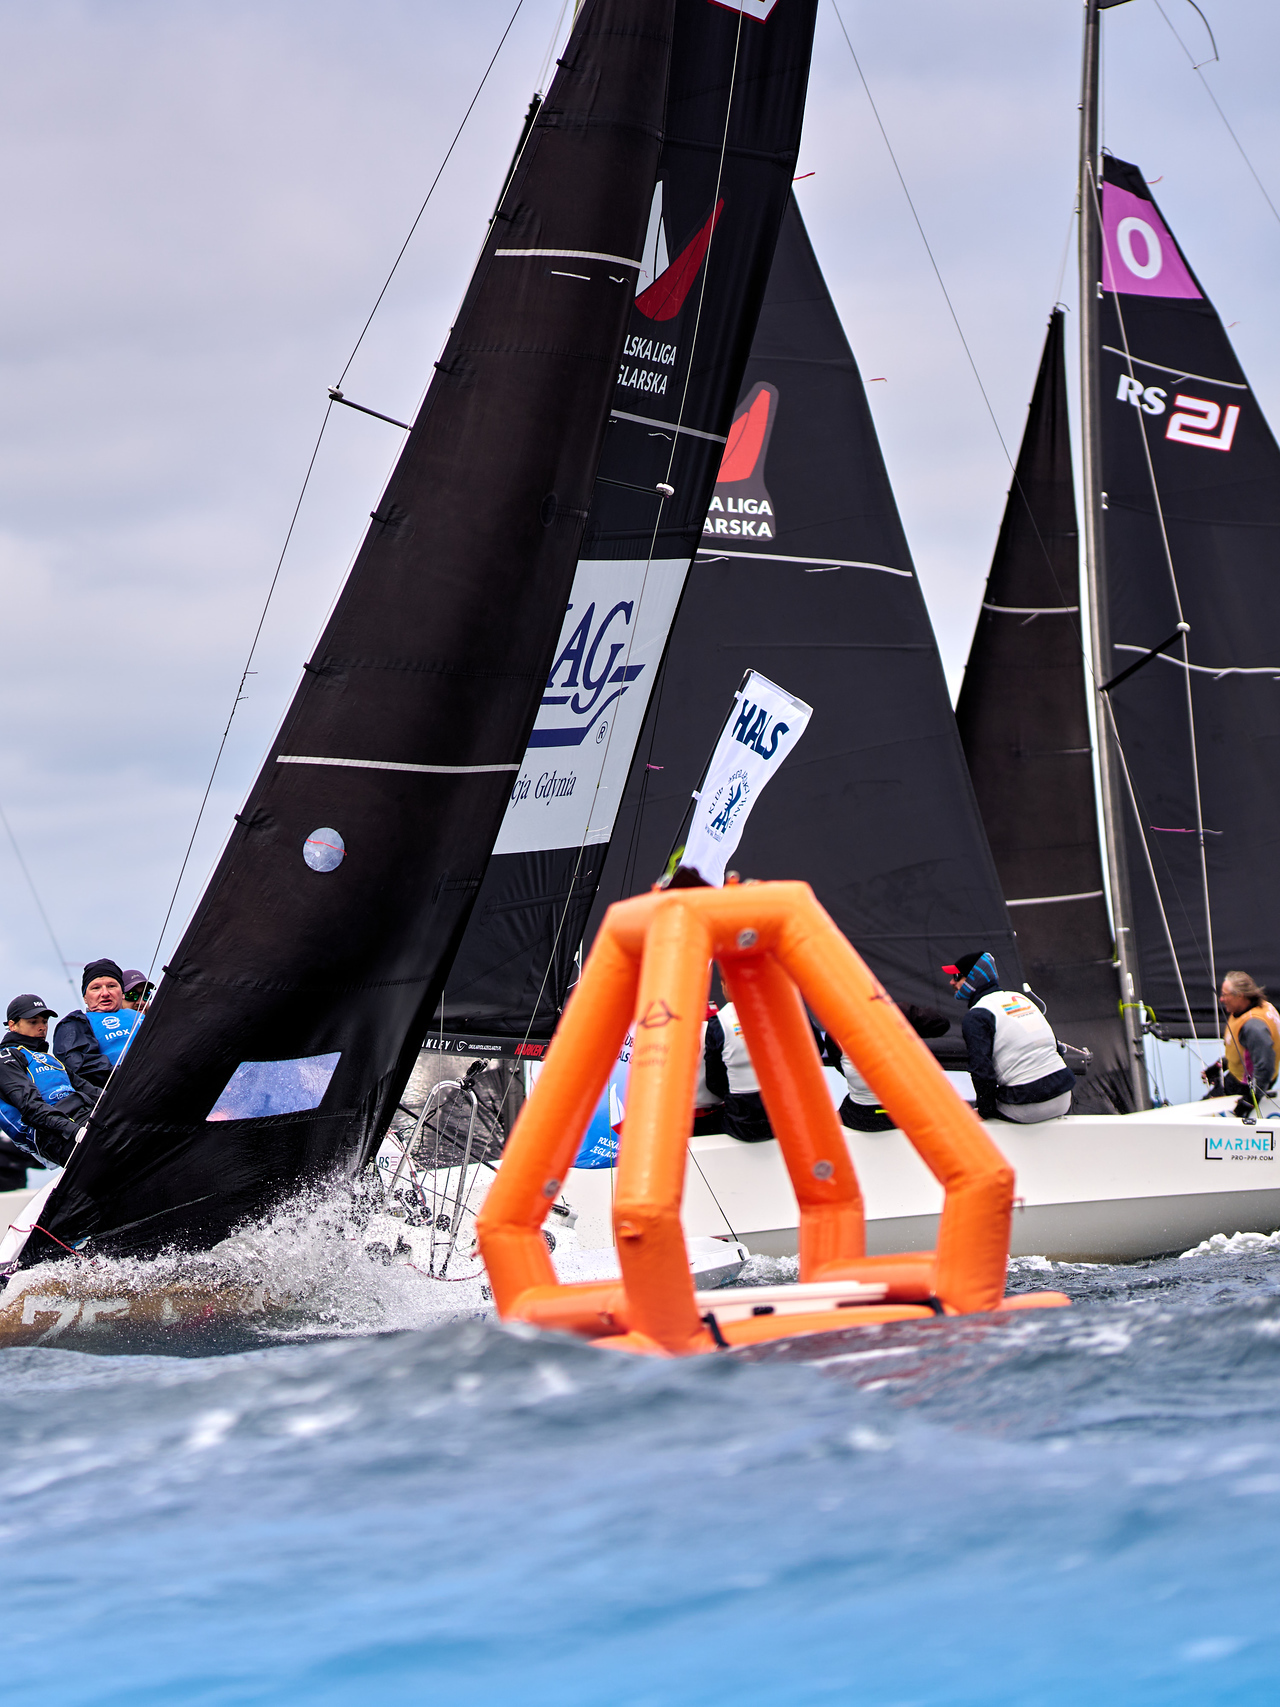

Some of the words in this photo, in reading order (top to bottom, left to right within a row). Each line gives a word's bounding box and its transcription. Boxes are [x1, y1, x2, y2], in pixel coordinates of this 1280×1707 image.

[1116, 216, 1163, 280] 0
[652, 341, 677, 366] LIGA
[1116, 373, 1168, 416] RS
[1165, 393, 1241, 452] 21
[727, 497, 773, 517] LIGA
[731, 698, 790, 761] HALS
[534, 770, 577, 806] Gdynia
[1209, 1138, 1271, 1151] MARINE
